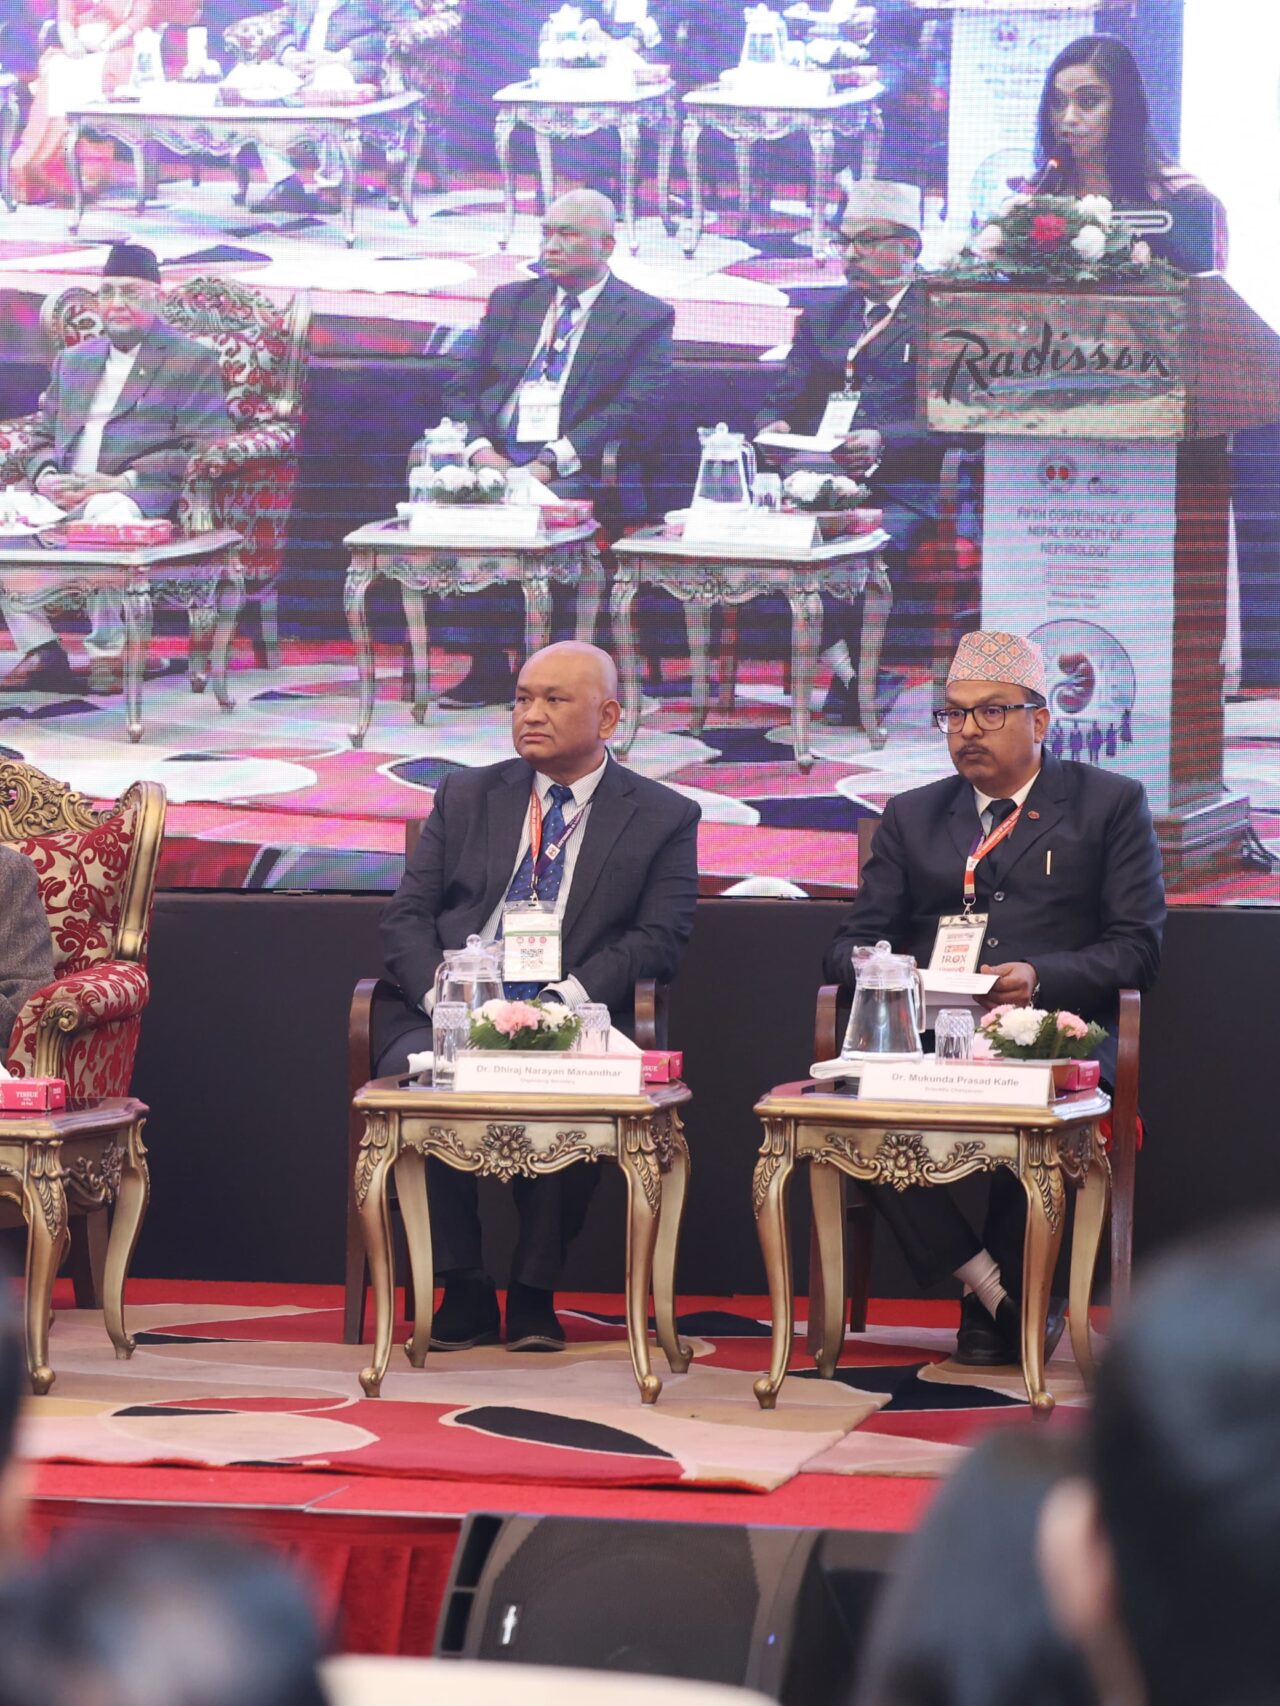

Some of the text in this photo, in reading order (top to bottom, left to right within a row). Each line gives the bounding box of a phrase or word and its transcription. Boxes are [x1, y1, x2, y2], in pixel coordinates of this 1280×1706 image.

[942, 322, 1173, 404] Radisson
[524, 1067, 565, 1076] Narayan
[569, 1068, 623, 1078] Manandhar
[908, 1074, 954, 1084] Mukunda
[956, 1076, 991, 1086] Prasad
